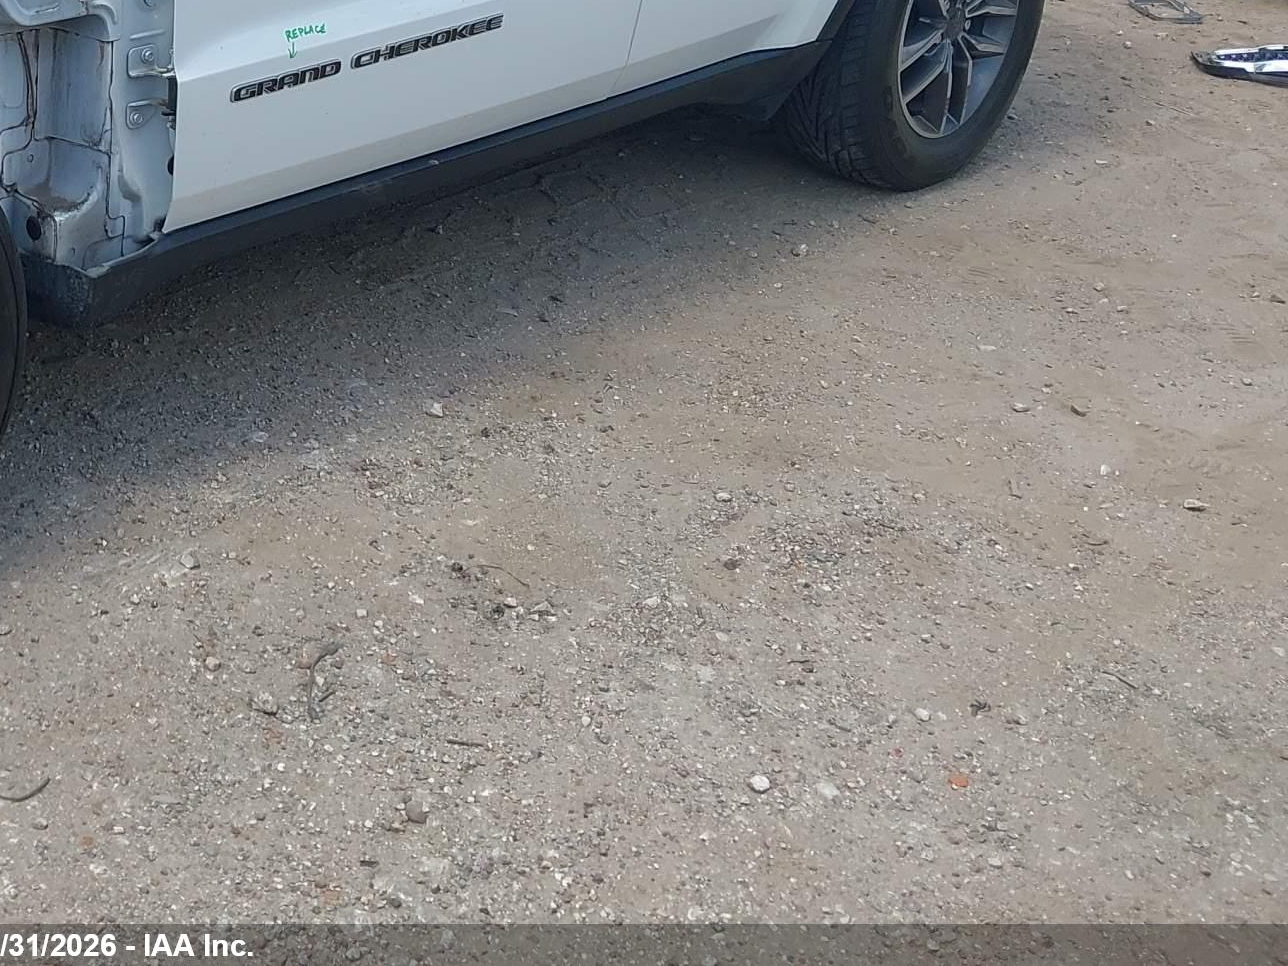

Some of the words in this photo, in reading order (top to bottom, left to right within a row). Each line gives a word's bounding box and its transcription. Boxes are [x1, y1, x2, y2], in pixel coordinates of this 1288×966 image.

[229, 58, 342, 103] GRAND
[350, 12, 505, 70] CHEROKEE
[285, 23, 327, 42] REPLACE
